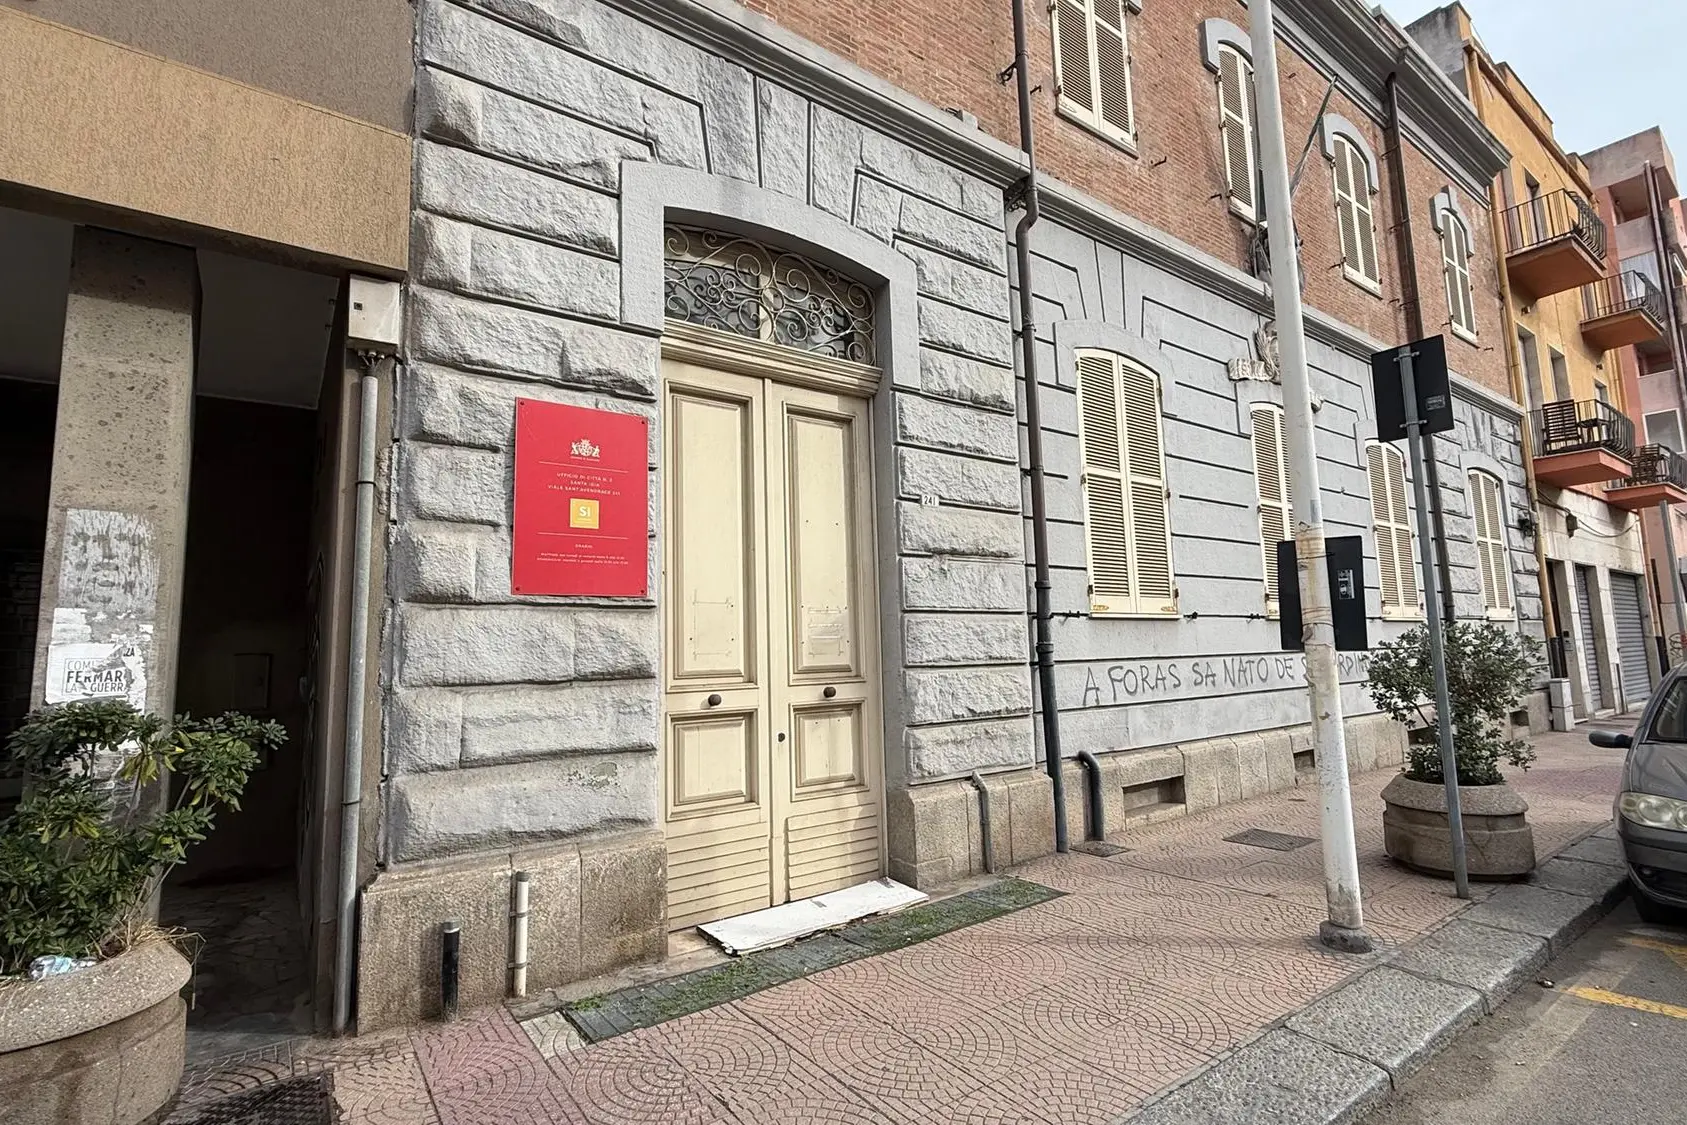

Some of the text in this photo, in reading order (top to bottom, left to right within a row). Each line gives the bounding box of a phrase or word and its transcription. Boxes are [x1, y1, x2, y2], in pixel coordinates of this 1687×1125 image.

[924, 495, 936, 506] 241
[1082, 665, 1100, 707] A
[1107, 663, 1182, 703] FORAS
[1192, 661, 1217, 688] SA
[1223, 656, 1269, 688] NATO
[1275, 656, 1295, 681] DE
